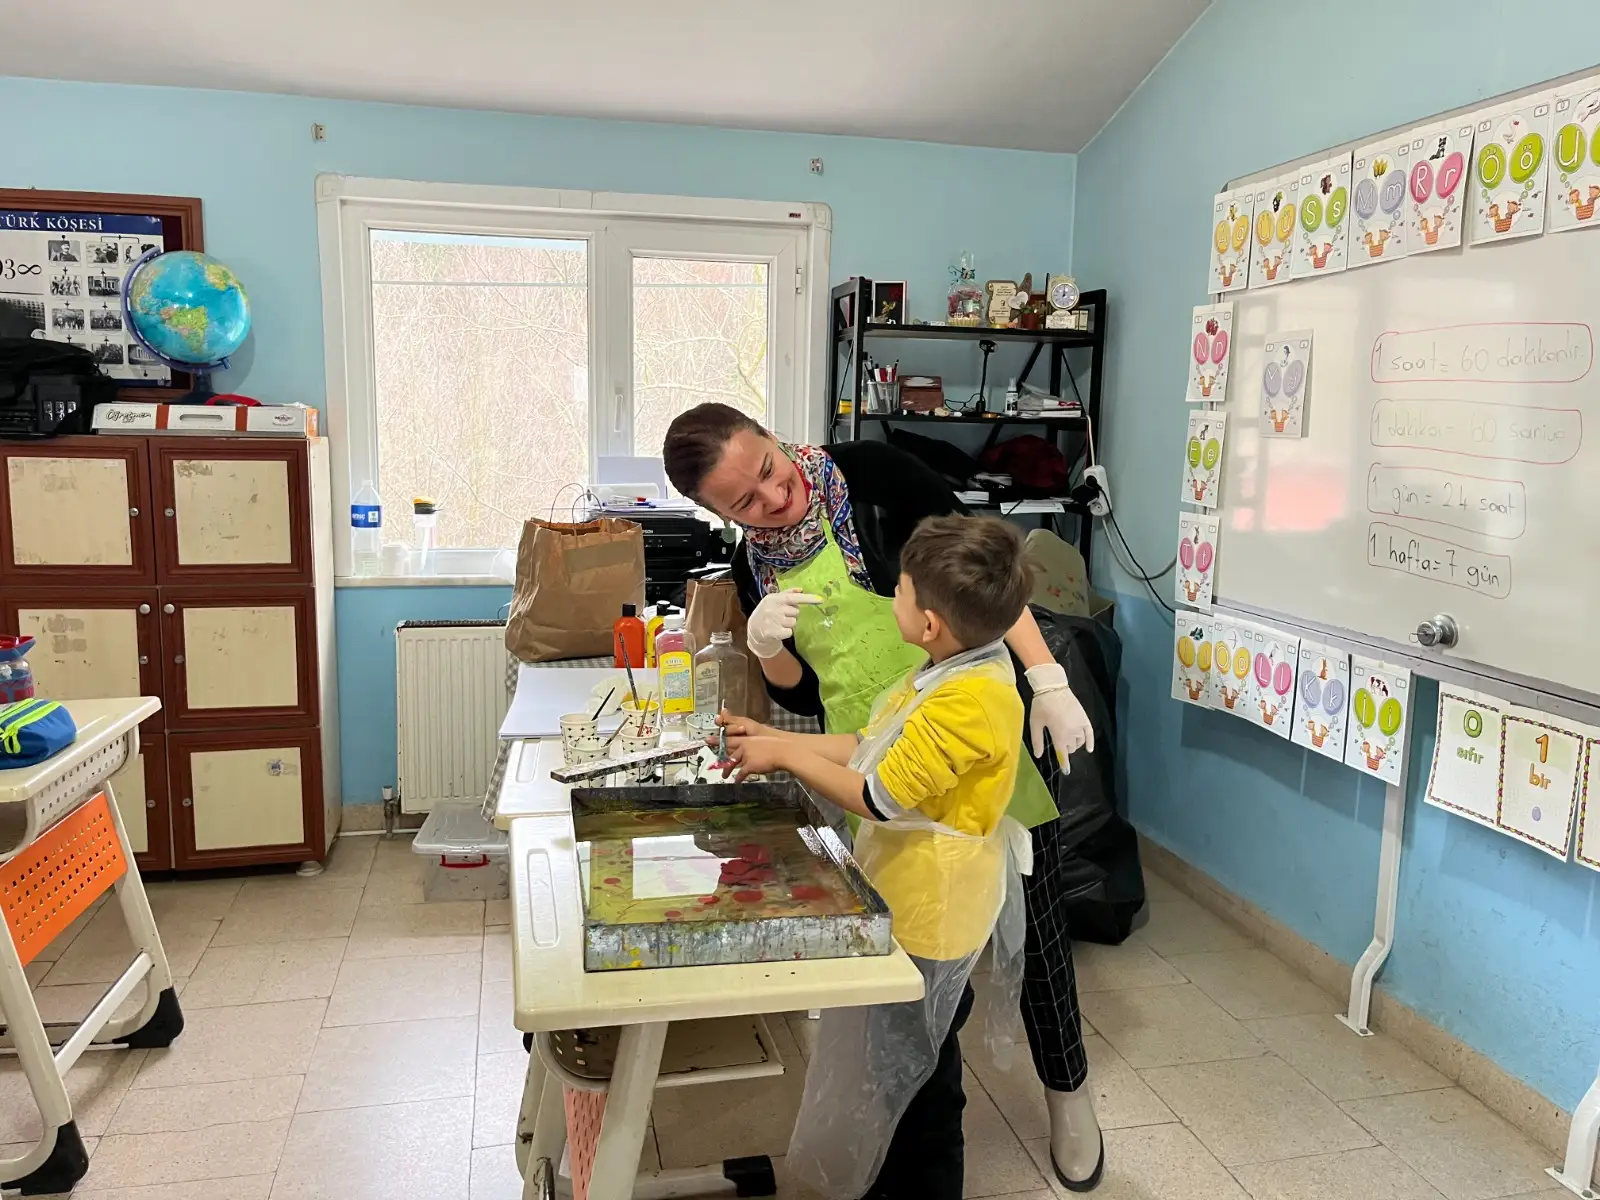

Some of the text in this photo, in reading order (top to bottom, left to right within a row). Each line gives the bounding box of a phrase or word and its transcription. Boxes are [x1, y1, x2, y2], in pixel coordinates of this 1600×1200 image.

[1559, 128, 1580, 166] U
[1482, 143, 1534, 183] Ö ö
[1415, 165, 1457, 197] R r
[1356, 182, 1402, 212] M m
[0, 214, 103, 232] ÜRK KÖŞESİ
[1305, 200, 1342, 226] S s
[1196, 339, 1224, 359] N n
[1375, 341, 1383, 370] 1
[1460, 344, 1490, 373] 60
[1267, 367, 1279, 392] Y
[1373, 411, 1380, 438] 1
[1470, 408, 1497, 443] 60
[1391, 484, 1419, 514] gün
[1442, 481, 1468, 511] 24
[1478, 492, 1517, 517] saat
[1182, 542, 1192, 565] T
[1370, 532, 1376, 558] 1
[1445, 549, 1458, 577] 7
[1467, 564, 1501, 588] gün
[1259, 656, 1269, 684] L
[1304, 674, 1339, 710] K k
[1463, 709, 1483, 738] 0
[1535, 733, 1549, 764] 1
[1529, 762, 1552, 790] bir
